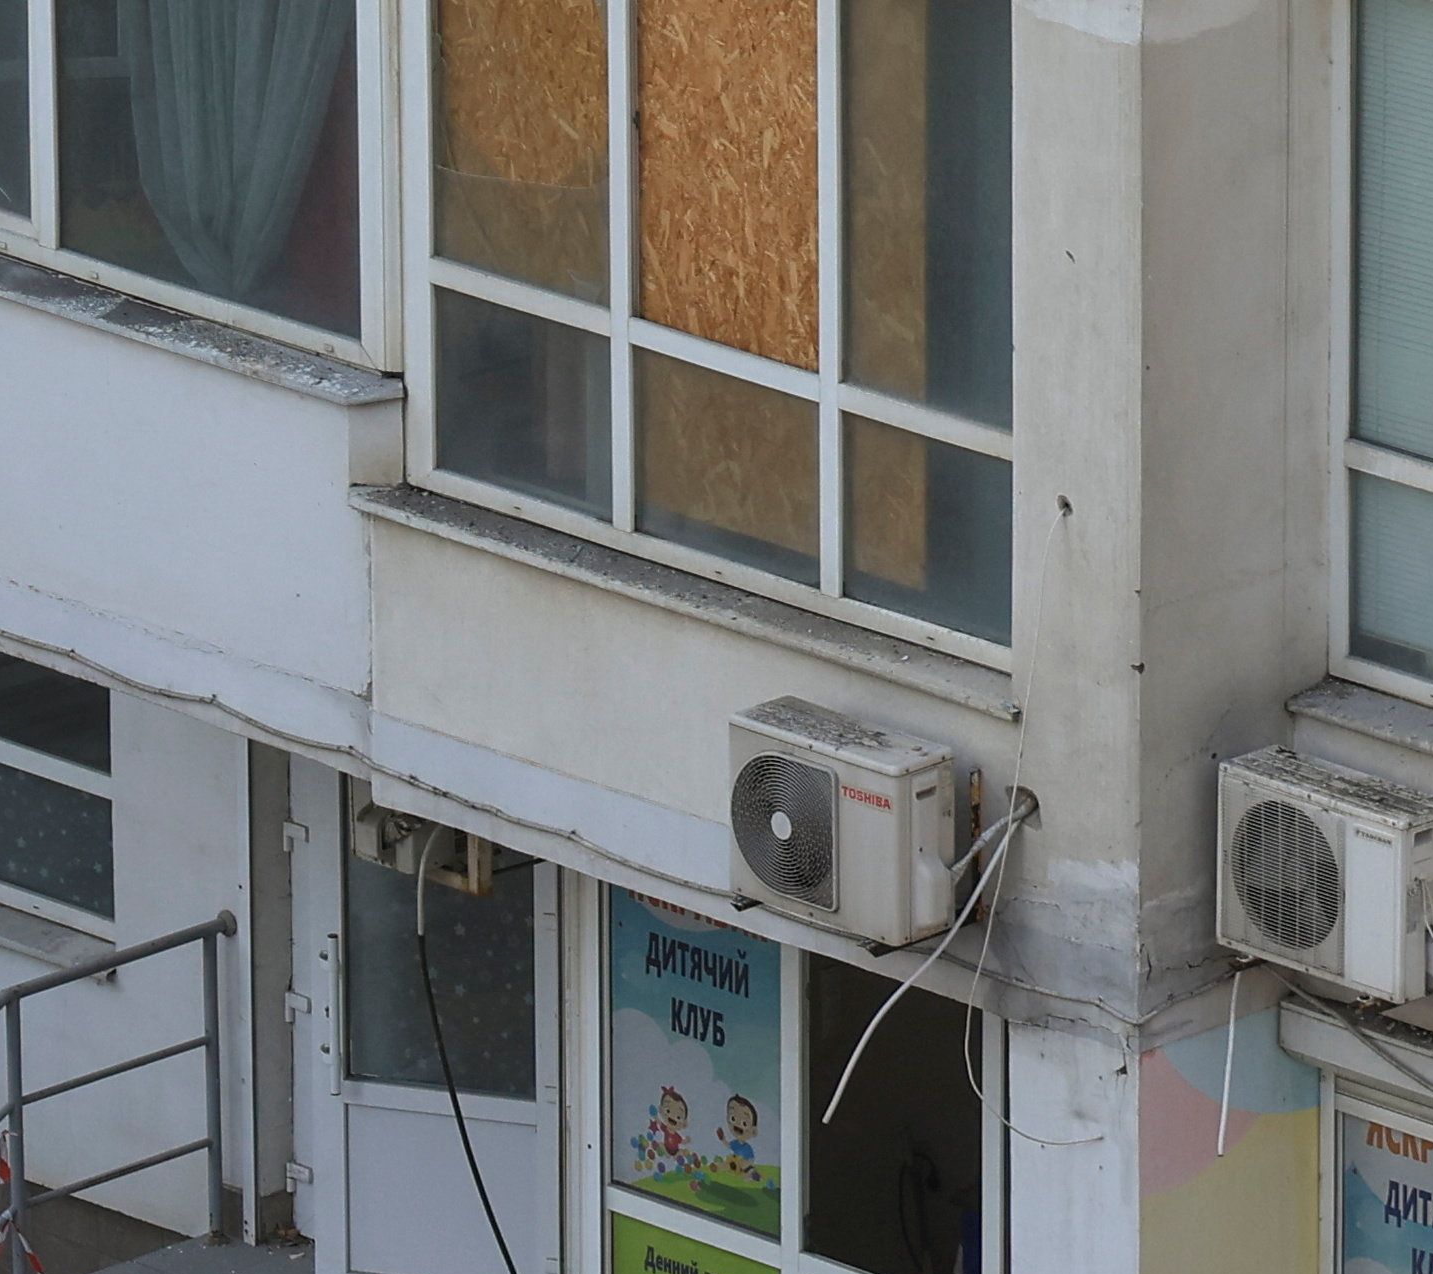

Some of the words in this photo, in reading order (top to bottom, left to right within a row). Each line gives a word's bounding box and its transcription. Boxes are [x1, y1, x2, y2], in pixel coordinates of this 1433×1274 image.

[841, 785, 891, 810] TOSHIBA
[645, 931, 749, 998] ДИТЯЧИЙ
[671, 997, 725, 1047] КЛУБ
